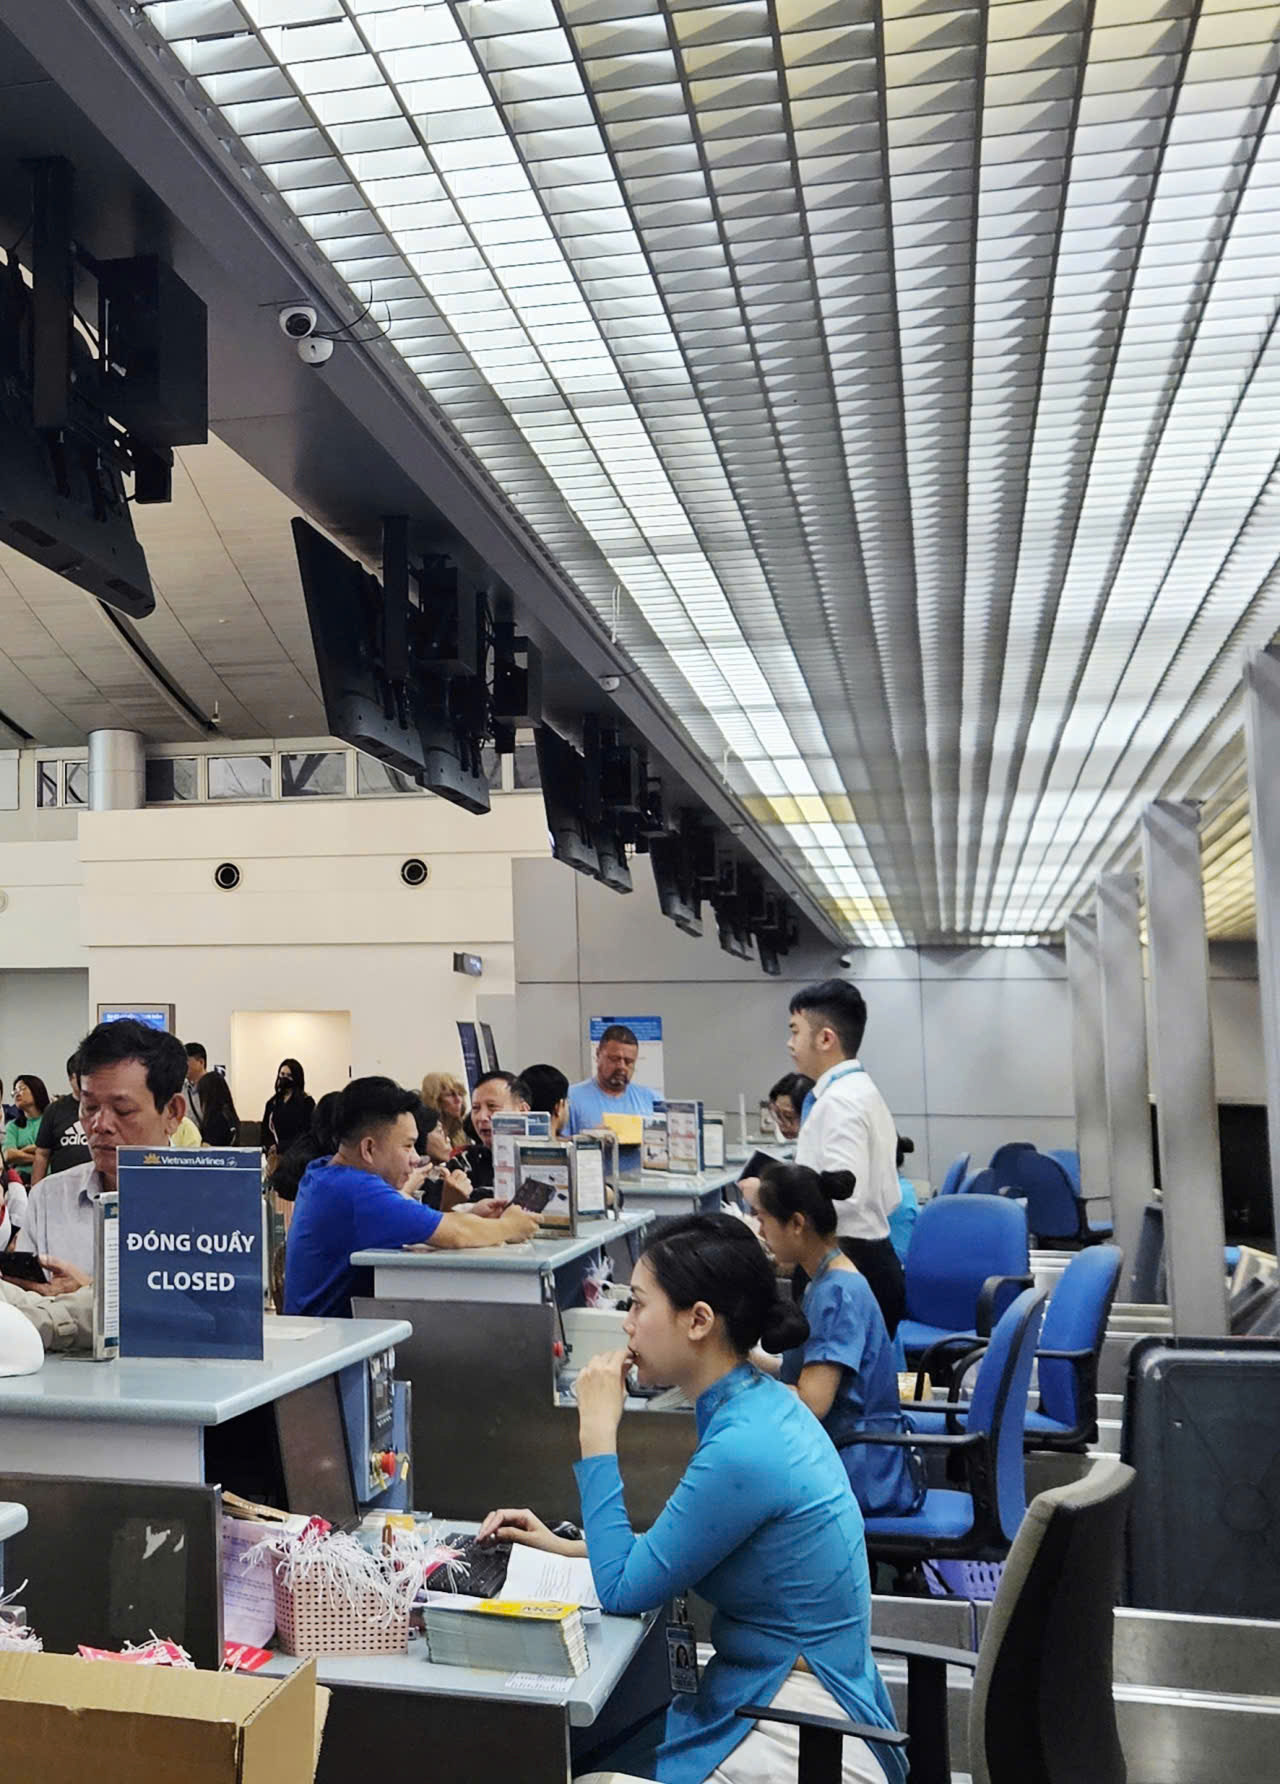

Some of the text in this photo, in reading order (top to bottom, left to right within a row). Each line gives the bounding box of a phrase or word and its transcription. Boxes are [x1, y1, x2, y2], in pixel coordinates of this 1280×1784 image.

[161, 1155, 225, 1166] VietnamAirlines
[126, 1230, 191, 1251] ĐÓNG
[147, 1271, 235, 1291] CLOSED
